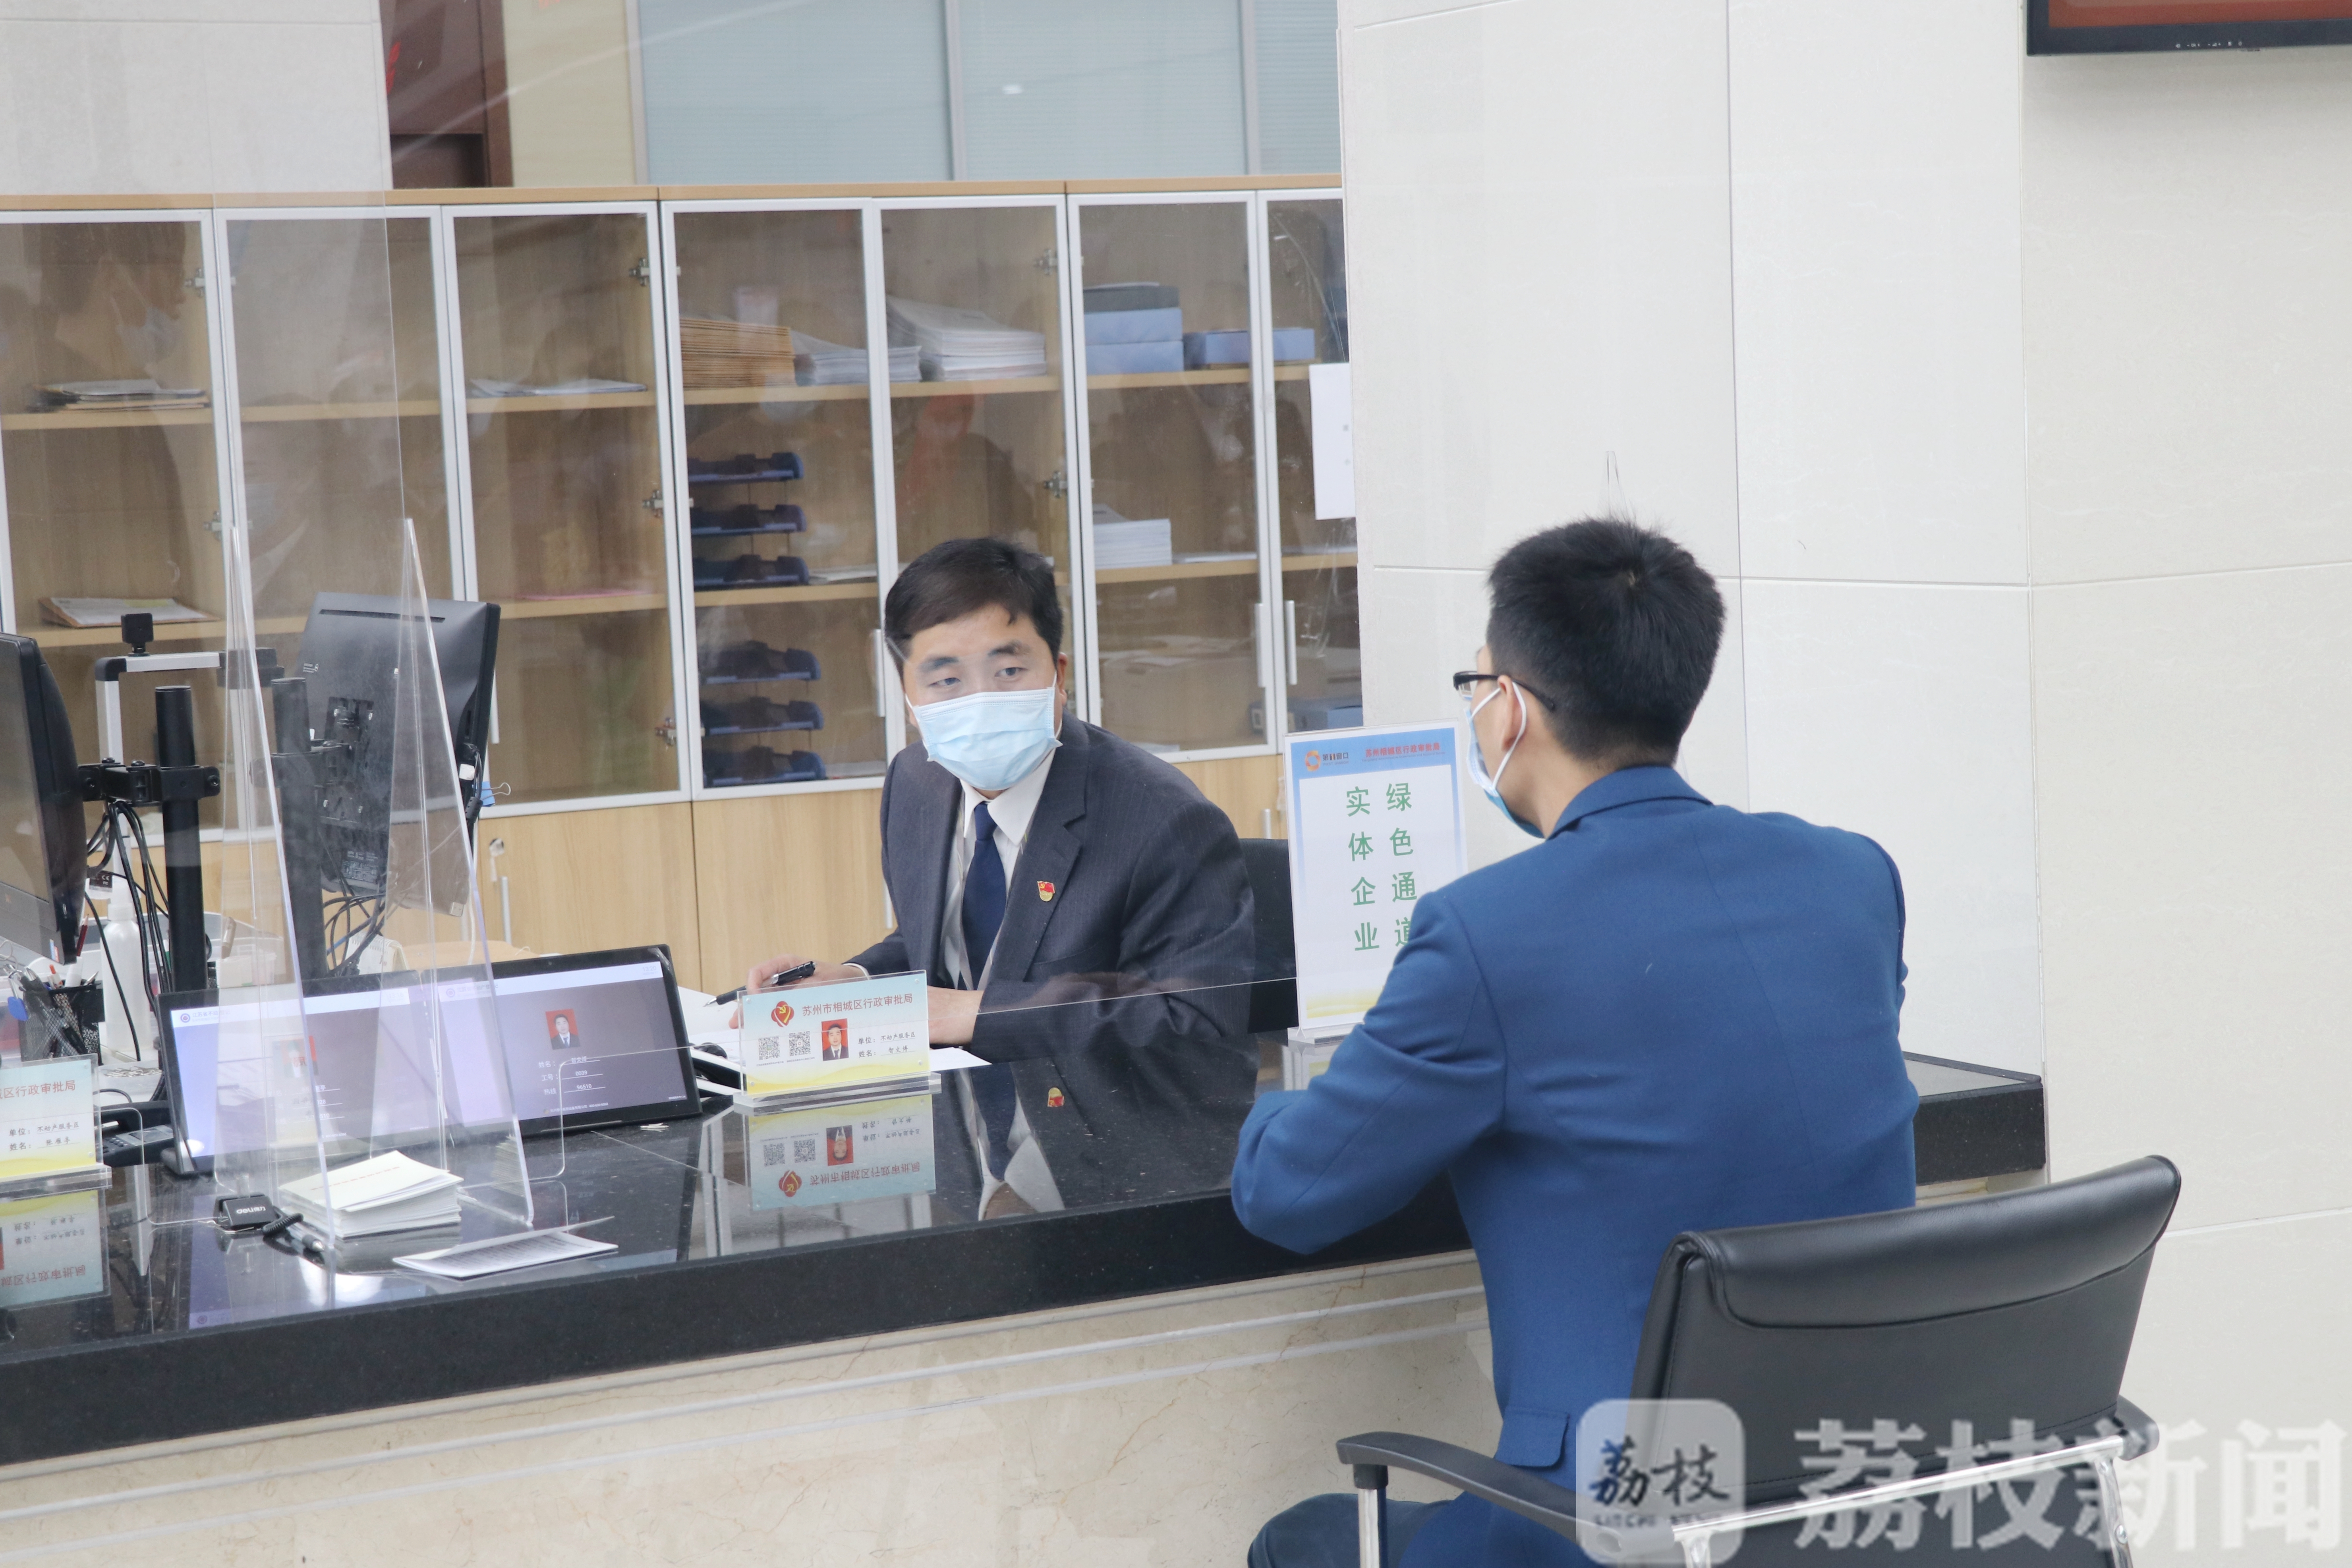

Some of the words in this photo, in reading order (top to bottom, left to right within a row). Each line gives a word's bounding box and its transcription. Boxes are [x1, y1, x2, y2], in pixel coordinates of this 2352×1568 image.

[1365, 742, 1440, 757] 苏州相城区行政审批局
[1346, 786, 1380, 951] 实体企业
[802, 993, 913, 1016] 苏州市相城区行政审批局
[881, 1031, 916, 1041] 不动产服务区
[888, 1045, 908, 1054] 智文博
[0, 1080, 76, 1099] 区行政审批局
[37, 1122, 79, 1132] 不动产服务区
